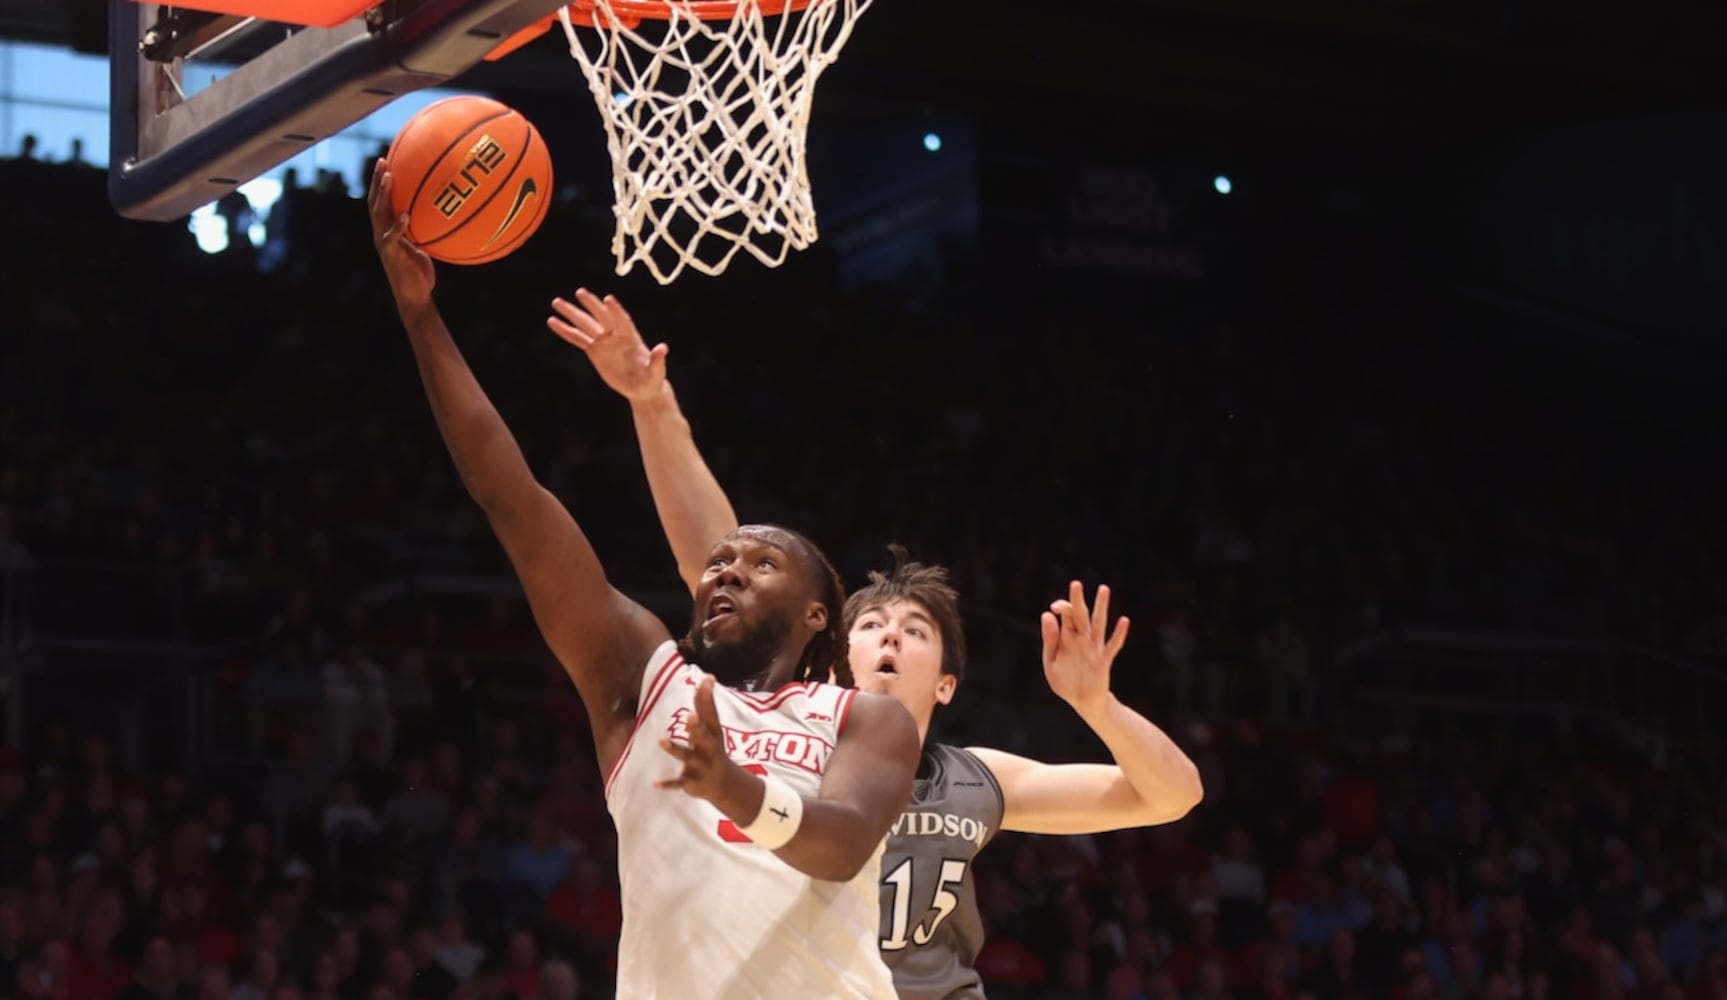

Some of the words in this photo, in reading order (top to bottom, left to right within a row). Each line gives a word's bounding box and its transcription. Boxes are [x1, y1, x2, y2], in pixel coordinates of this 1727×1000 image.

[434, 139, 508, 220] ELITE
[667, 706, 836, 777] YTON
[887, 811, 988, 848] VIDSON
[879, 857, 968, 953] 15
